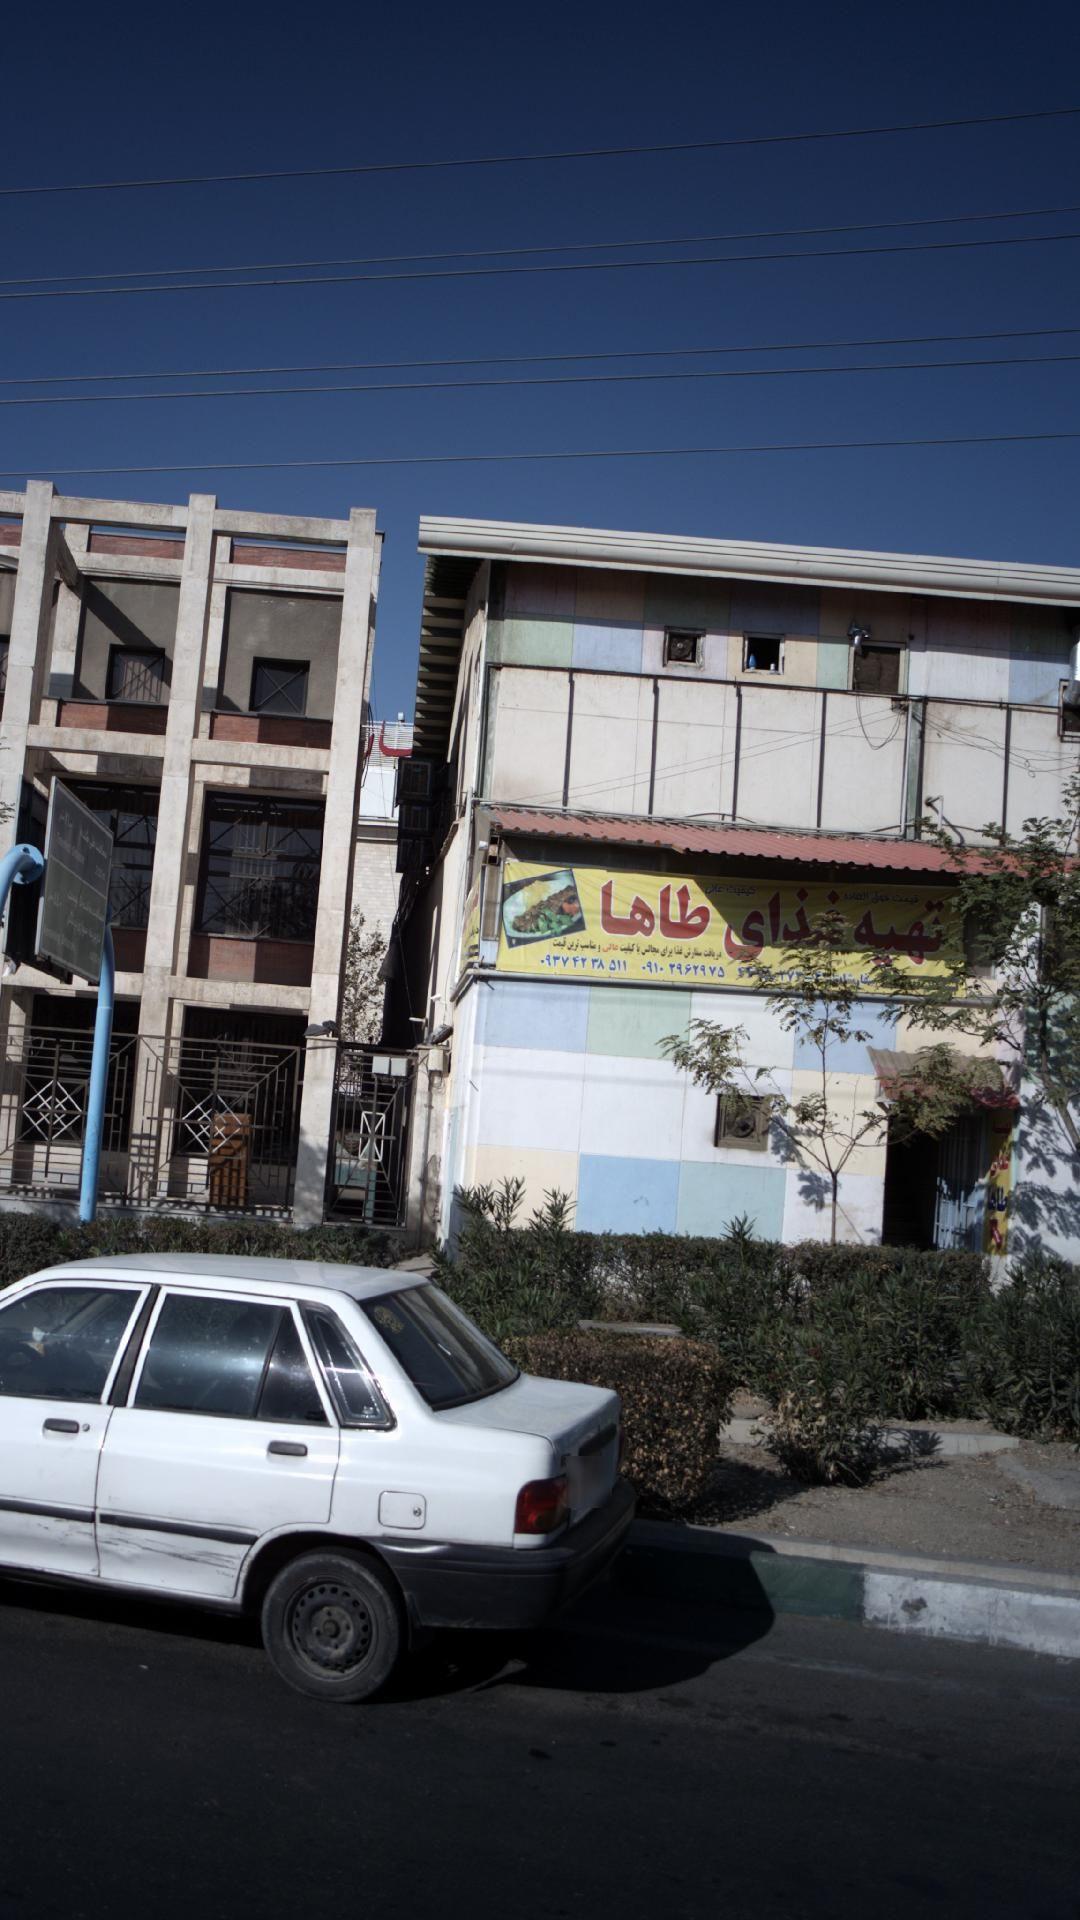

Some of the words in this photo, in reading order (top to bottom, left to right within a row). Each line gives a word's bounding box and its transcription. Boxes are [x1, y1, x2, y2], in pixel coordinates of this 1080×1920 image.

[601, 879, 711, 940] طاها
[724, 887, 842, 962] غذای
[854, 899, 945, 966] تهیه
